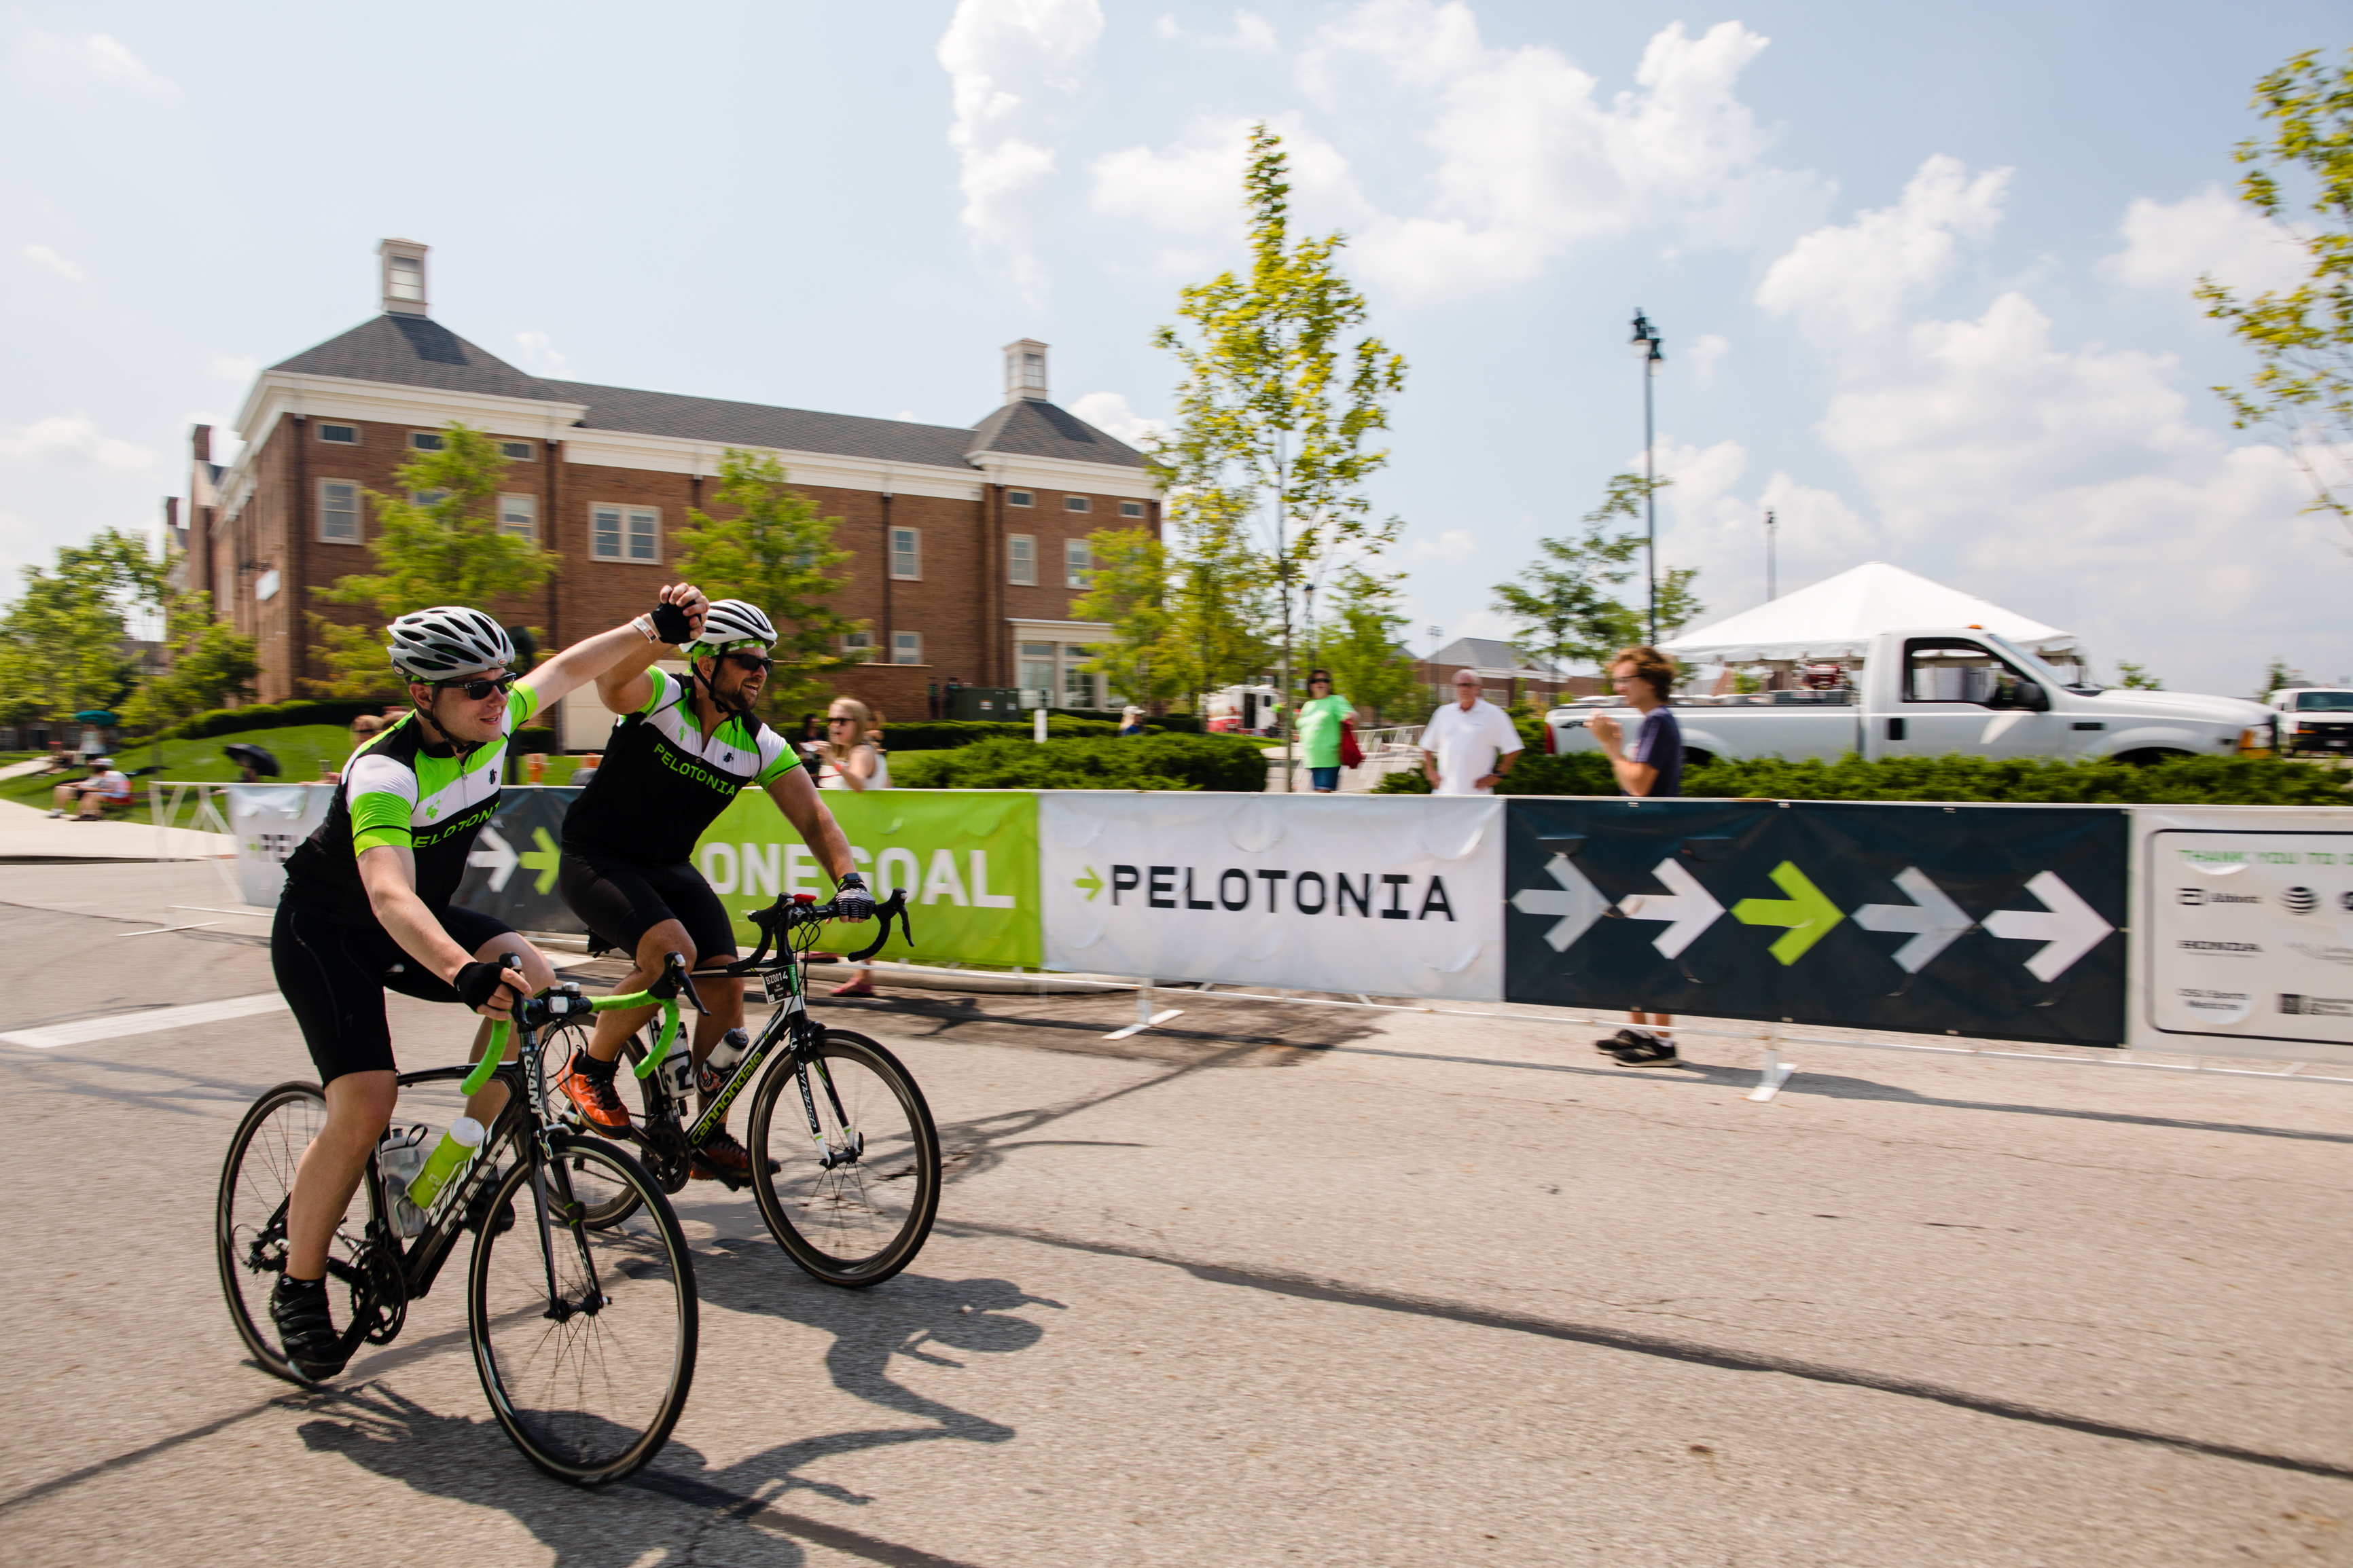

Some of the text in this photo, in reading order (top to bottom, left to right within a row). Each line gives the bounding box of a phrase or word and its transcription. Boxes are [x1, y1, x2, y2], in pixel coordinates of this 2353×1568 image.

[653, 743, 736, 796] PELOTONIA
[412, 801, 500, 847] ELOTONI
[700, 842, 822, 899] ONE
[1109, 864, 1458, 922] PELOTONIA
[765, 970, 788, 985] BZ0014
[791, 966, 799, 993] PELOTONI
[524, 1055, 541, 1114] GIANT
[691, 1052, 764, 1145] cannondale
